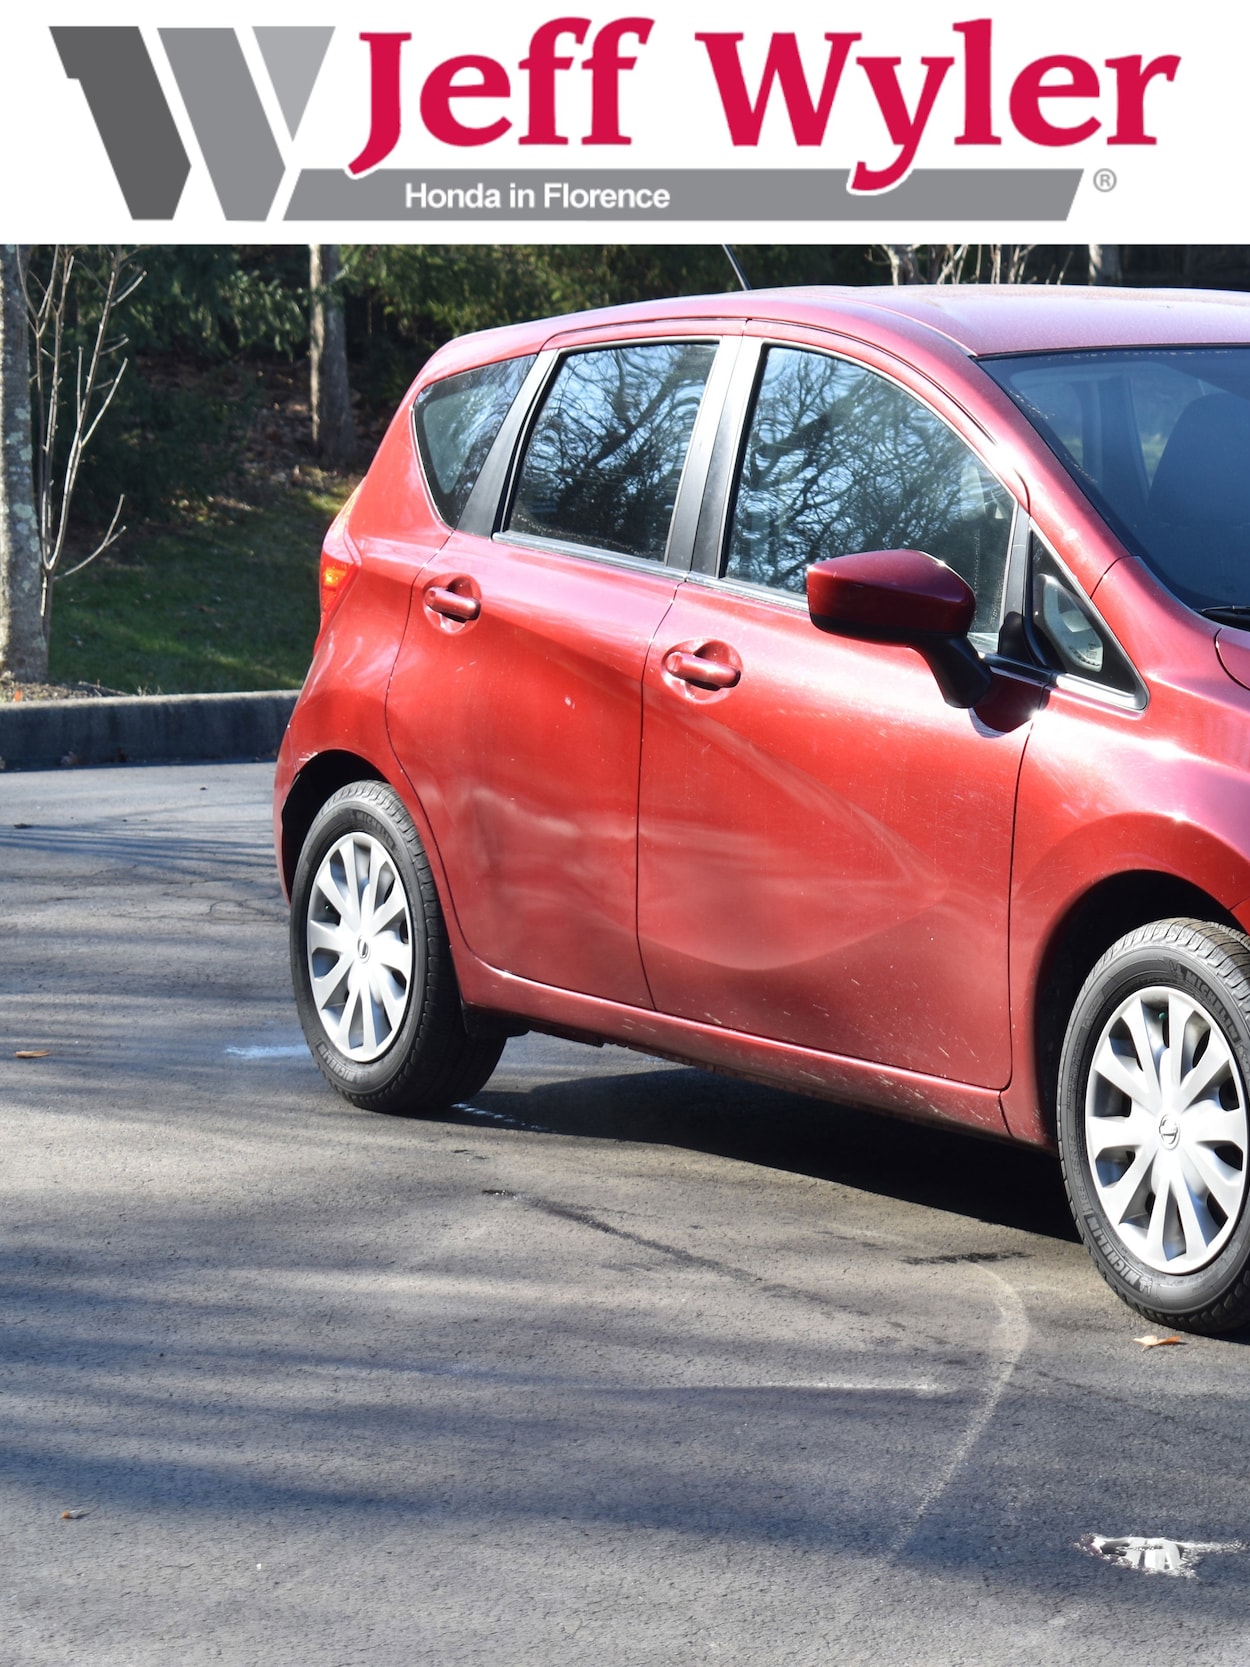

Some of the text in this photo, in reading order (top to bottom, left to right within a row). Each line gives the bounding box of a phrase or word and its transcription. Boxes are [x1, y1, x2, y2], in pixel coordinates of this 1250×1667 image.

[1185, 969, 1239, 1041] MICHELIN
[317, 1043, 356, 1082] MICHELIN
[1086, 1216, 1140, 1286] MICHELIN
